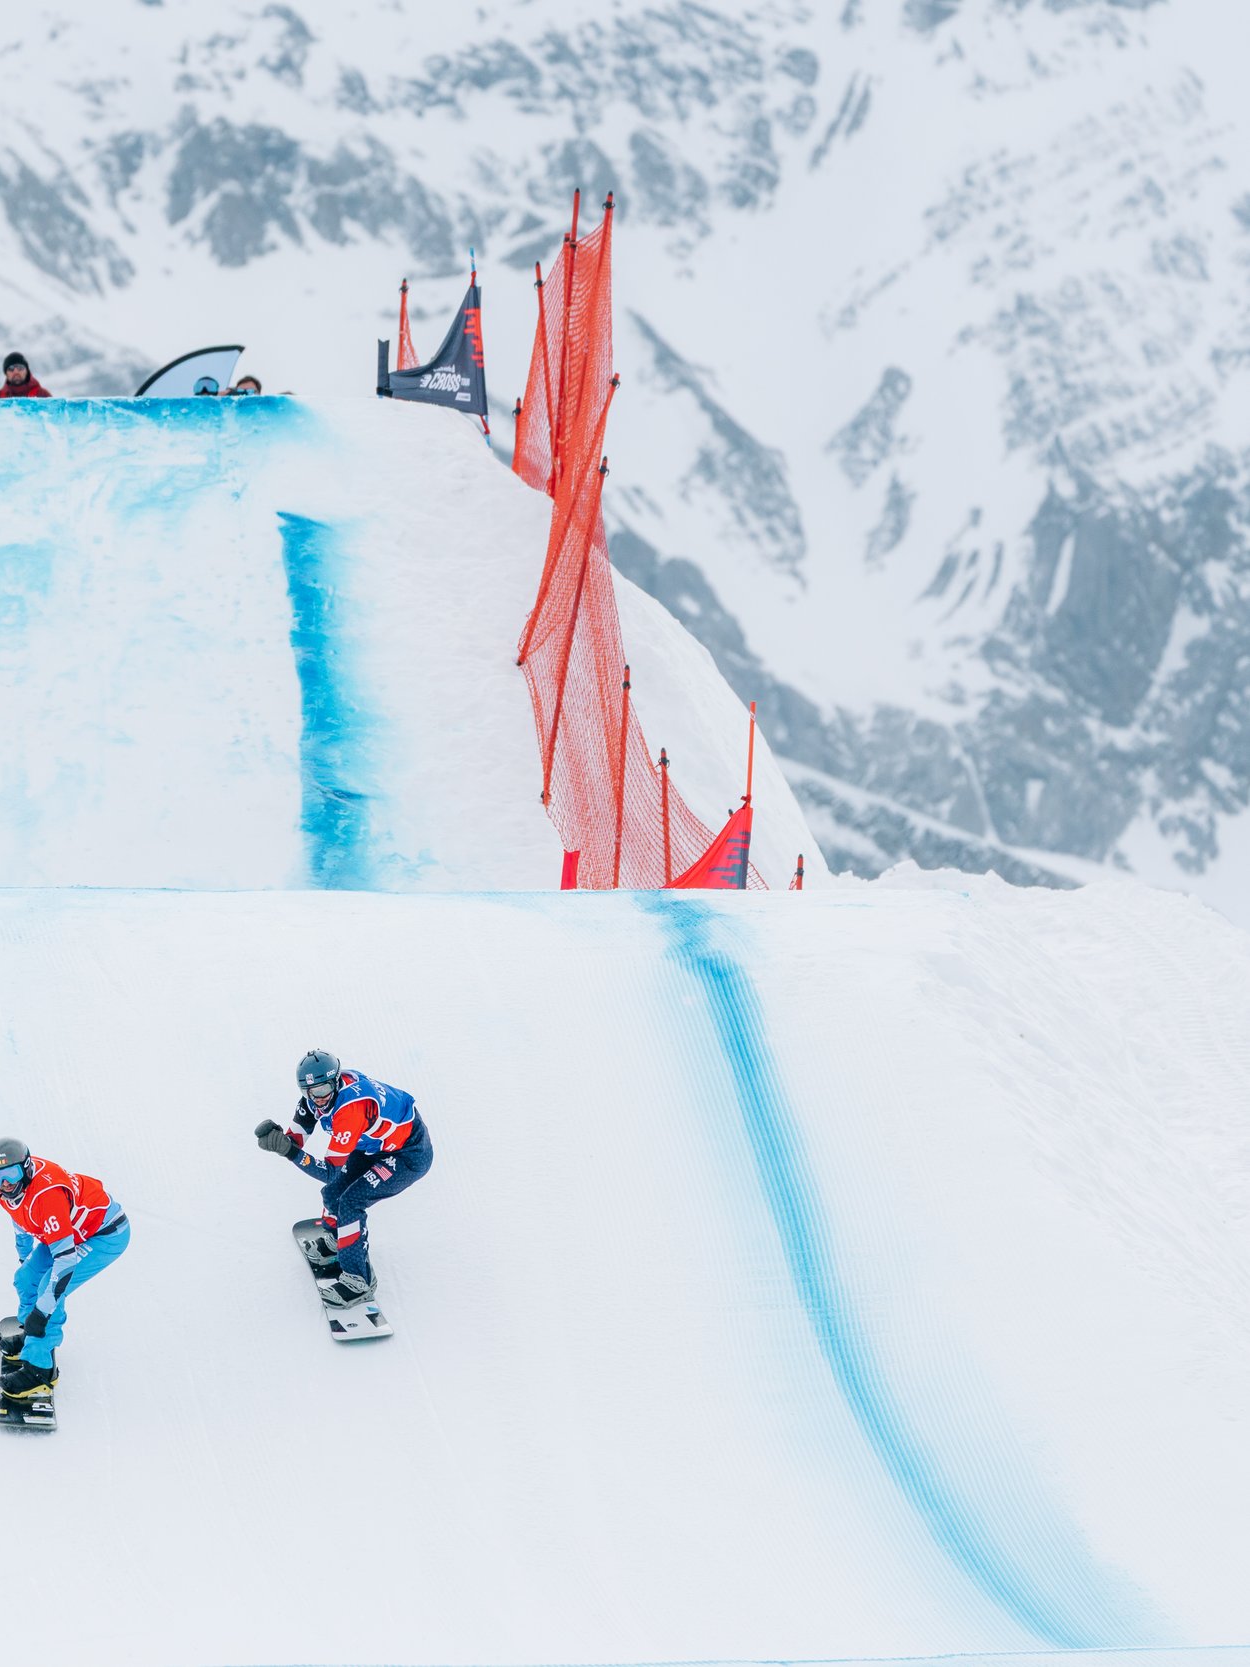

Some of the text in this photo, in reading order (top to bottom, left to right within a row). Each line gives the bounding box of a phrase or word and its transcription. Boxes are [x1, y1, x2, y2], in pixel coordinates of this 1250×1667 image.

[430, 372, 461, 392] CROSS
[334, 1131, 352, 1145] 48
[363, 1169, 381, 1189] USA
[43, 1215, 60, 1235] 46
